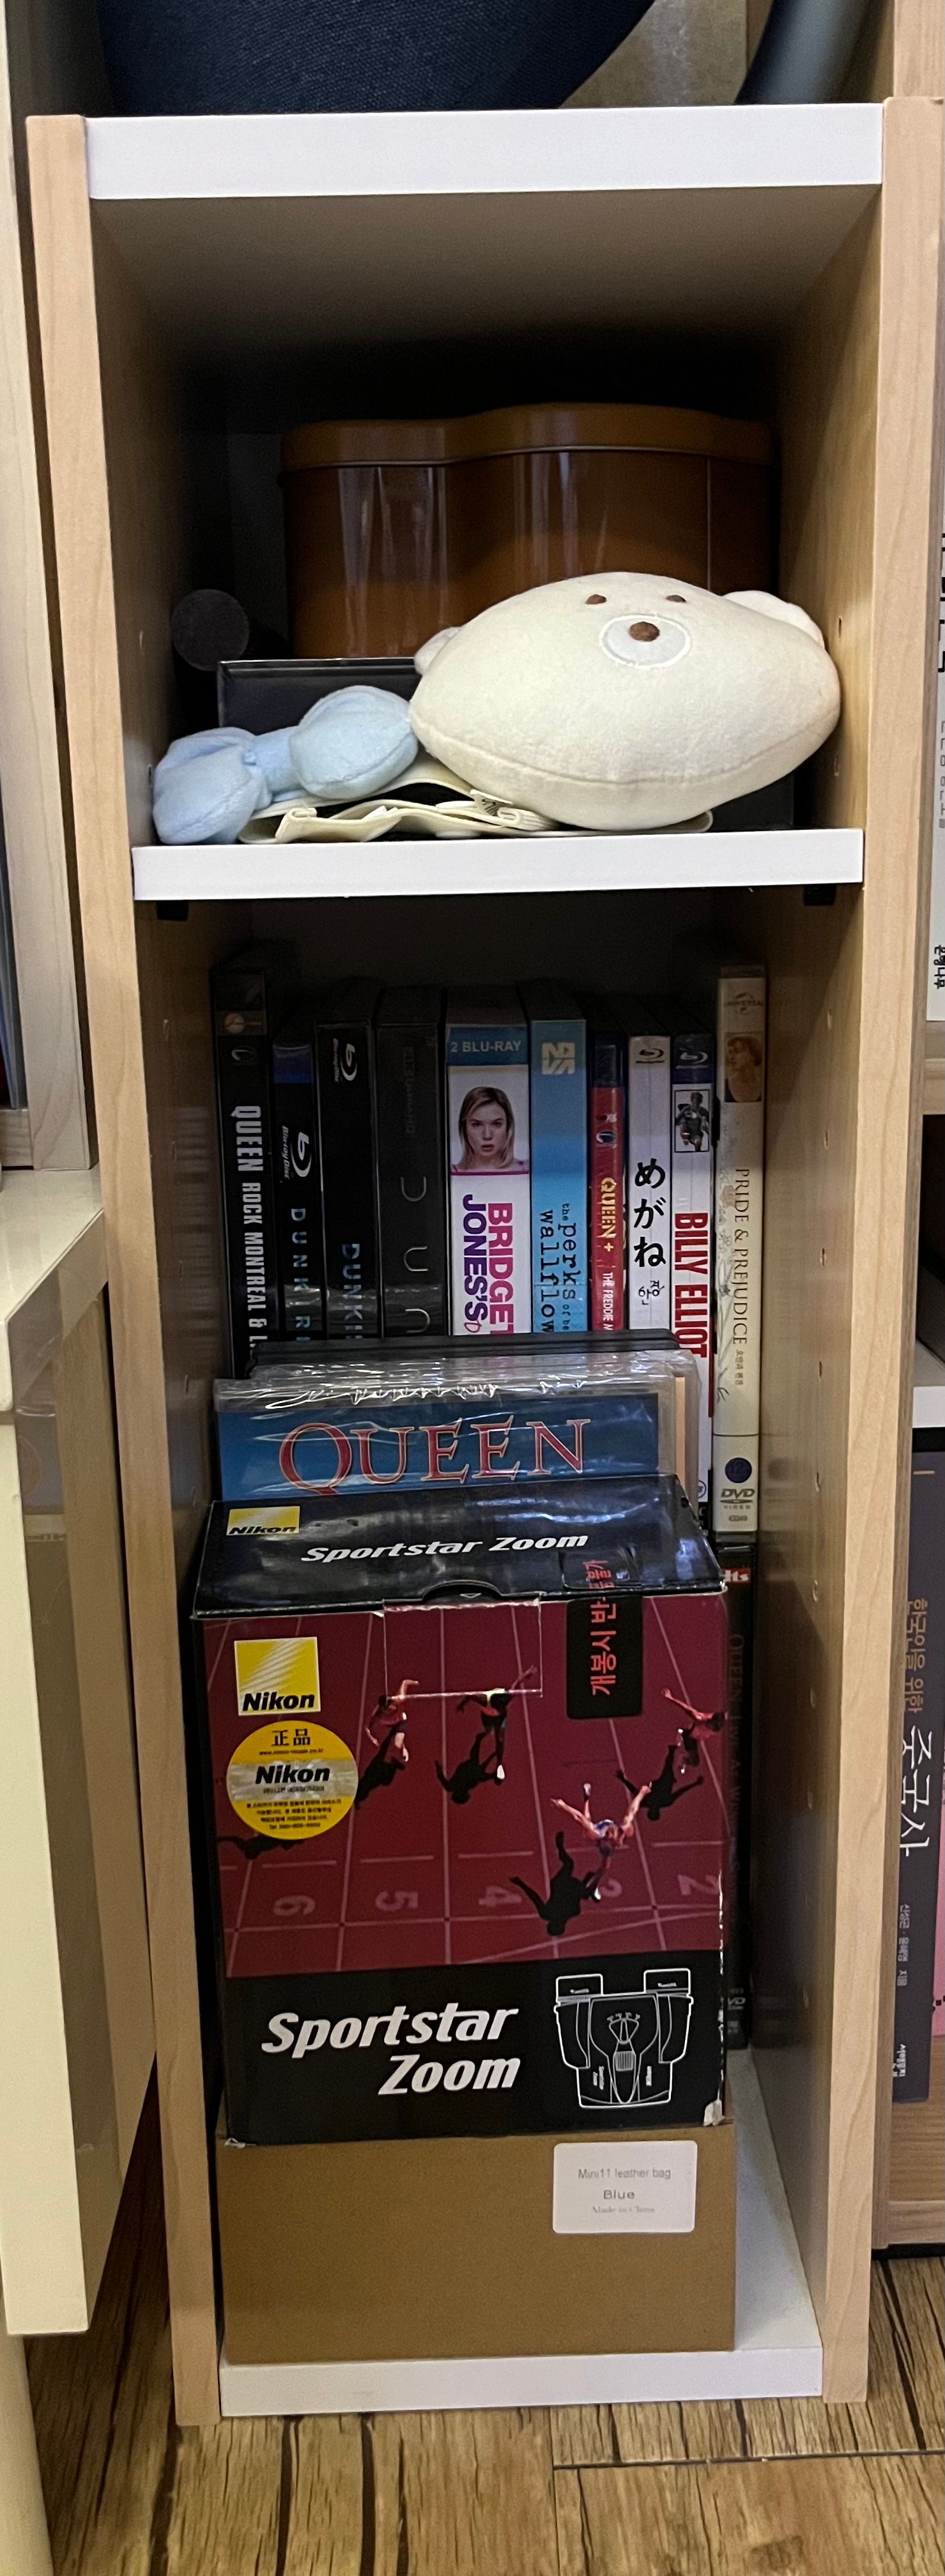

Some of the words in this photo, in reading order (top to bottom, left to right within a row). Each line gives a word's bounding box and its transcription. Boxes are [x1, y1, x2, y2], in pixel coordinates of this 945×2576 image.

[450, 1041, 458, 1053] 2
[463, 1040, 522, 1053] BLU-RAY
[231, 1105, 263, 1172] QUEEN
[242, 1182, 263, 1225] ROCK
[562, 1202, 571, 1222] the
[600, 1177, 617, 1239] QUEEN
[634, 1158, 666, 1268] めがね
[734, 1168, 749, 1223] PRIDE
[675, 1212, 709, 1275] BILLY
[735, 1228, 748, 1241] &
[244, 1232, 267, 1312] MONTREAL
[558, 1222, 581, 1301] perks
[602, 1271, 614, 1287] THE
[341, 1243, 363, 1340] DUNKI
[602, 1289, 614, 1322] FREDDIE
[733, 1248, 749, 1346] PREJUDICE
[249, 1318, 268, 1328] &
[562, 1304, 571, 1316] of
[278, 1415, 591, 1496] QUEEN
[720, 1487, 756, 1499] DVD
[229, 1526, 296, 1535] Nikon
[302, 1538, 482, 1564] Sportstar
[489, 1535, 588, 1552] Zoom
[590, 1630, 617, 1696] 개봉시
[242, 1691, 316, 1712] Nikon
[903, 1676, 925, 1714] 위한
[271, 1728, 311, 1747] 正品
[255, 1764, 330, 1784] Nikon
[261, 2003, 519, 2059] Sportstar
[378, 2054, 521, 2096] Zoom
[578, 2167, 611, 2179] Mini11
[615, 2168, 649, 2179] leather
[652, 2168, 672, 2180] bag
[603, 2189, 636, 2200] Blue
